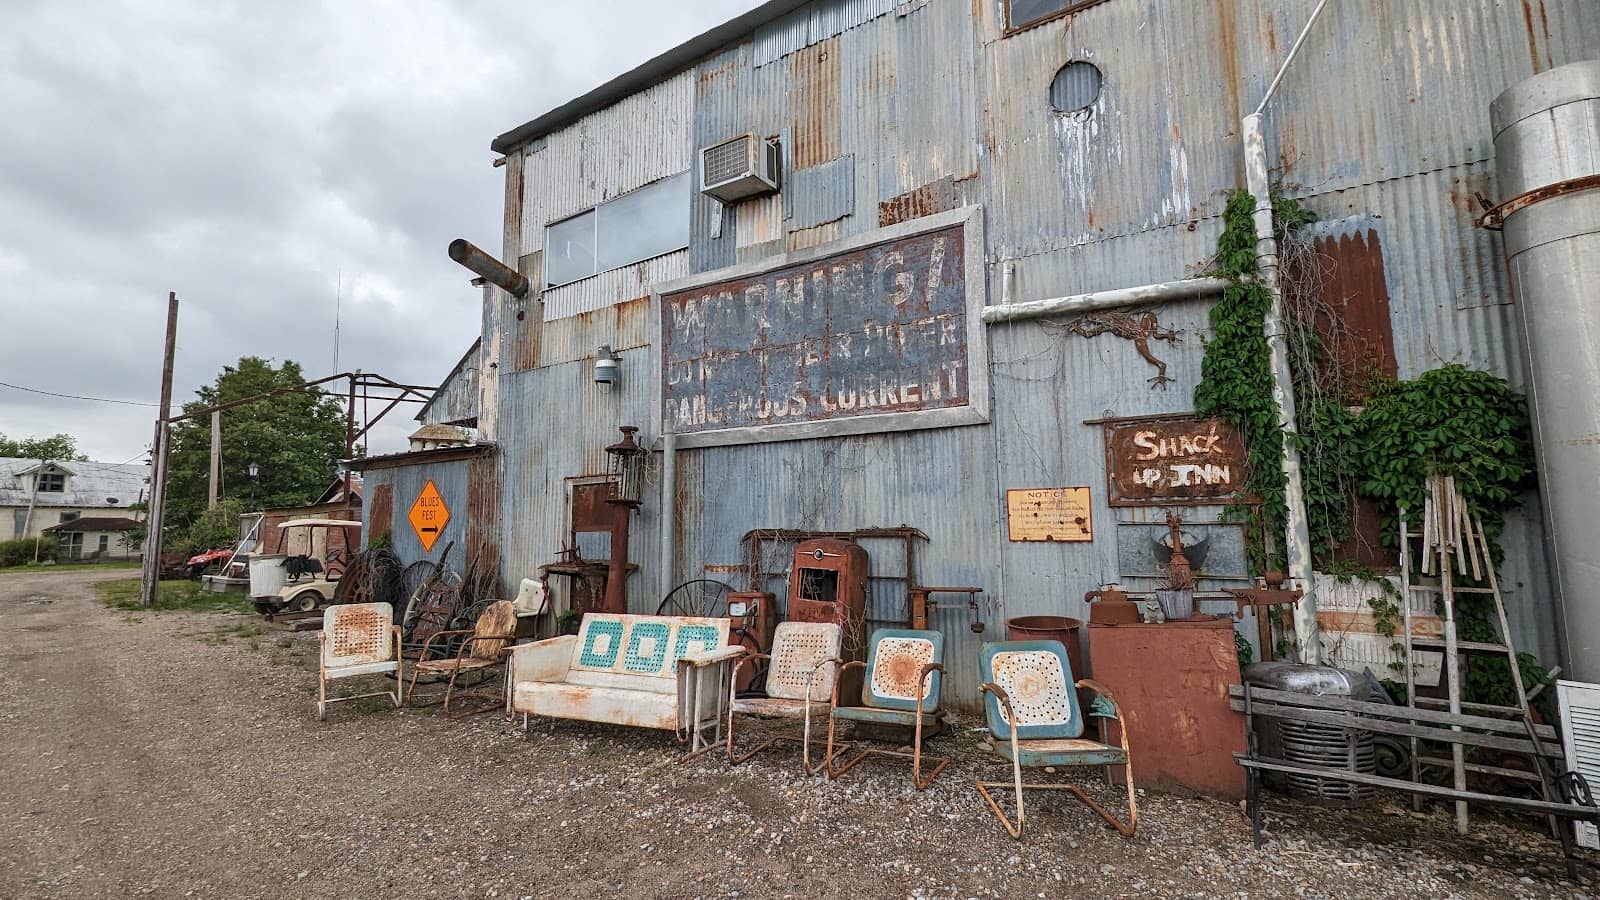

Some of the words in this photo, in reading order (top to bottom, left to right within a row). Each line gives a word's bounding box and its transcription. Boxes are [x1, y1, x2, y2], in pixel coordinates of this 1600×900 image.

[1170, 463, 1230, 487] INN
[420, 496, 440, 507] BLUES
[422, 510, 437, 521] FEST
